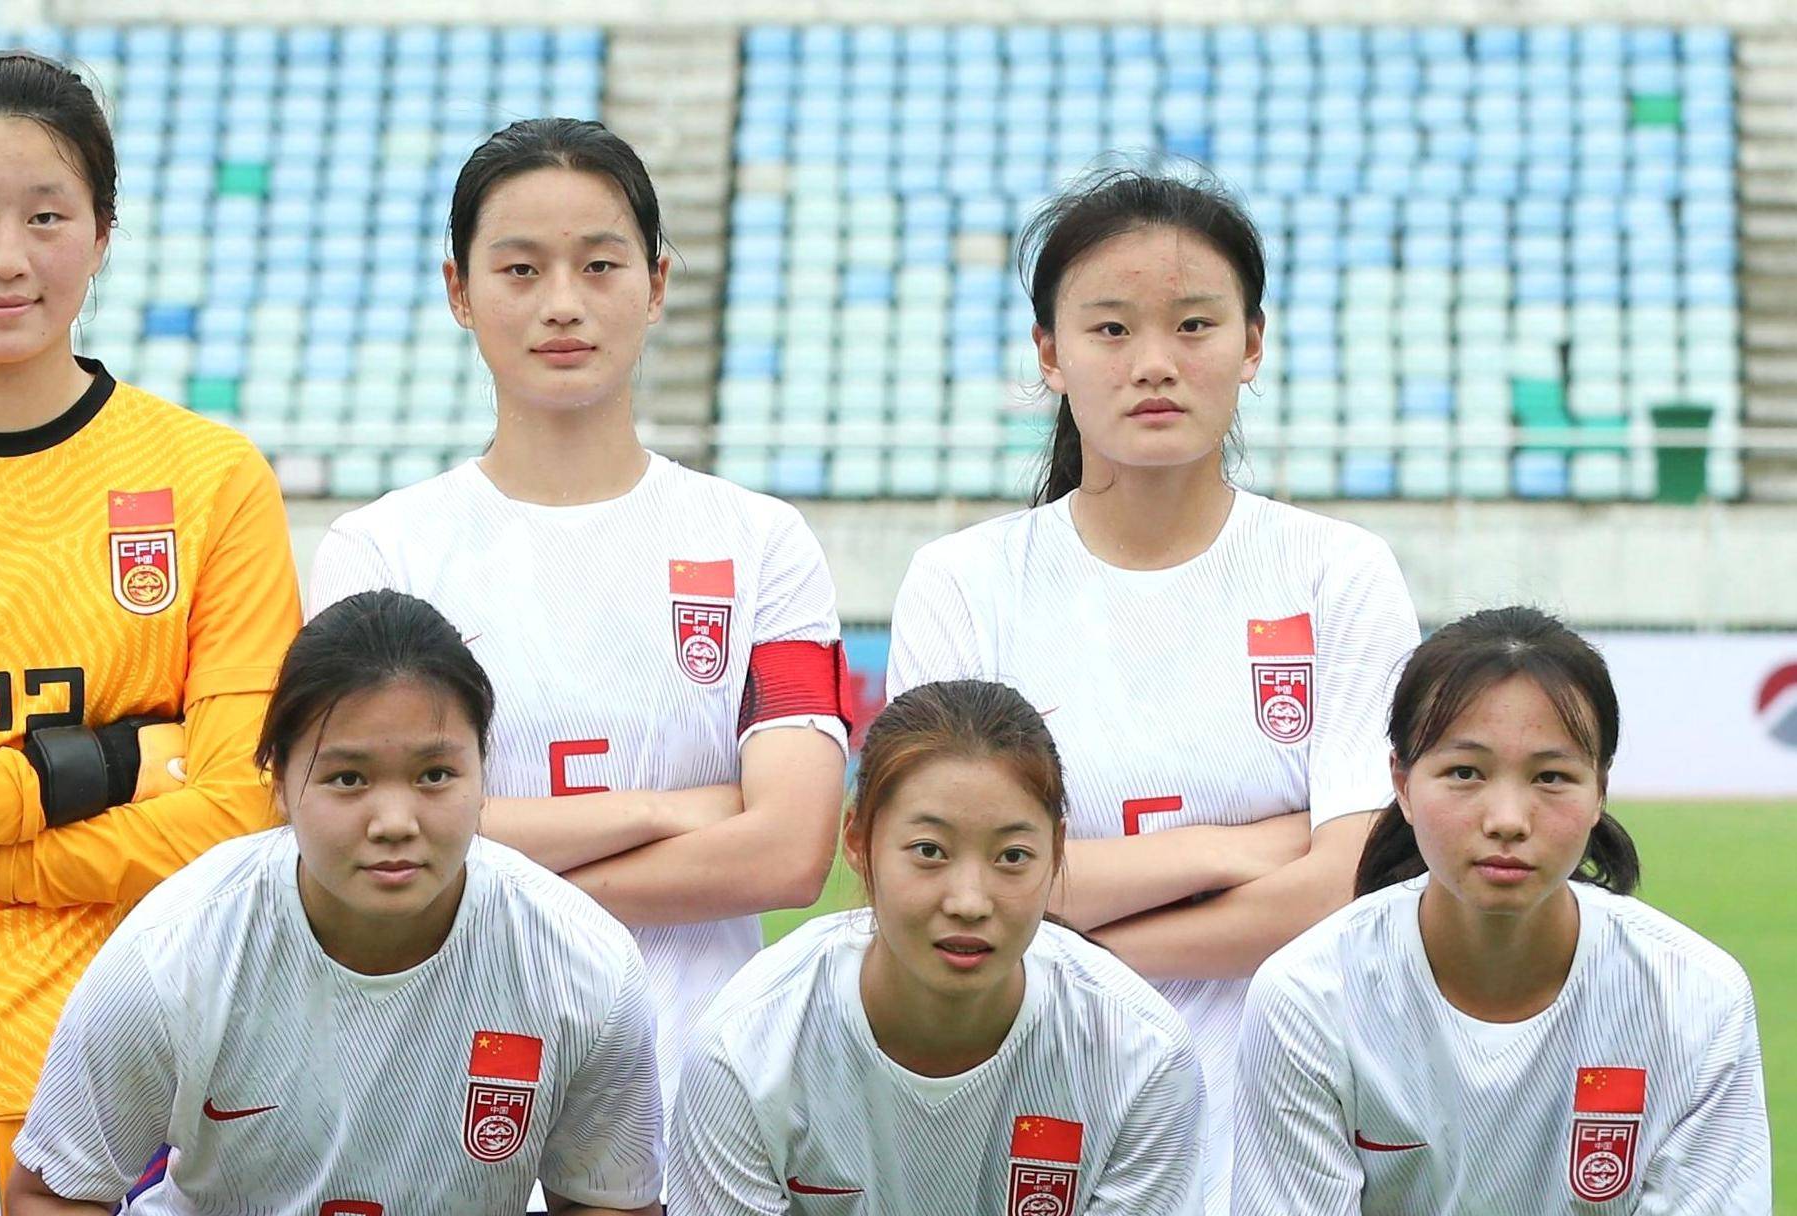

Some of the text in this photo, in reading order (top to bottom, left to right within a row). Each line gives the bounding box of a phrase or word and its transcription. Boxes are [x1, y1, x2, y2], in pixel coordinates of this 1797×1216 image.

[120, 541, 166, 557] CFA
[679, 609, 723, 626] CFA
[1260, 670, 1305, 686] CFA
[476, 1091, 524, 1107] CFA
[1581, 1129, 1628, 1143] CFA
[1019, 1172, 1067, 1186] CFA
